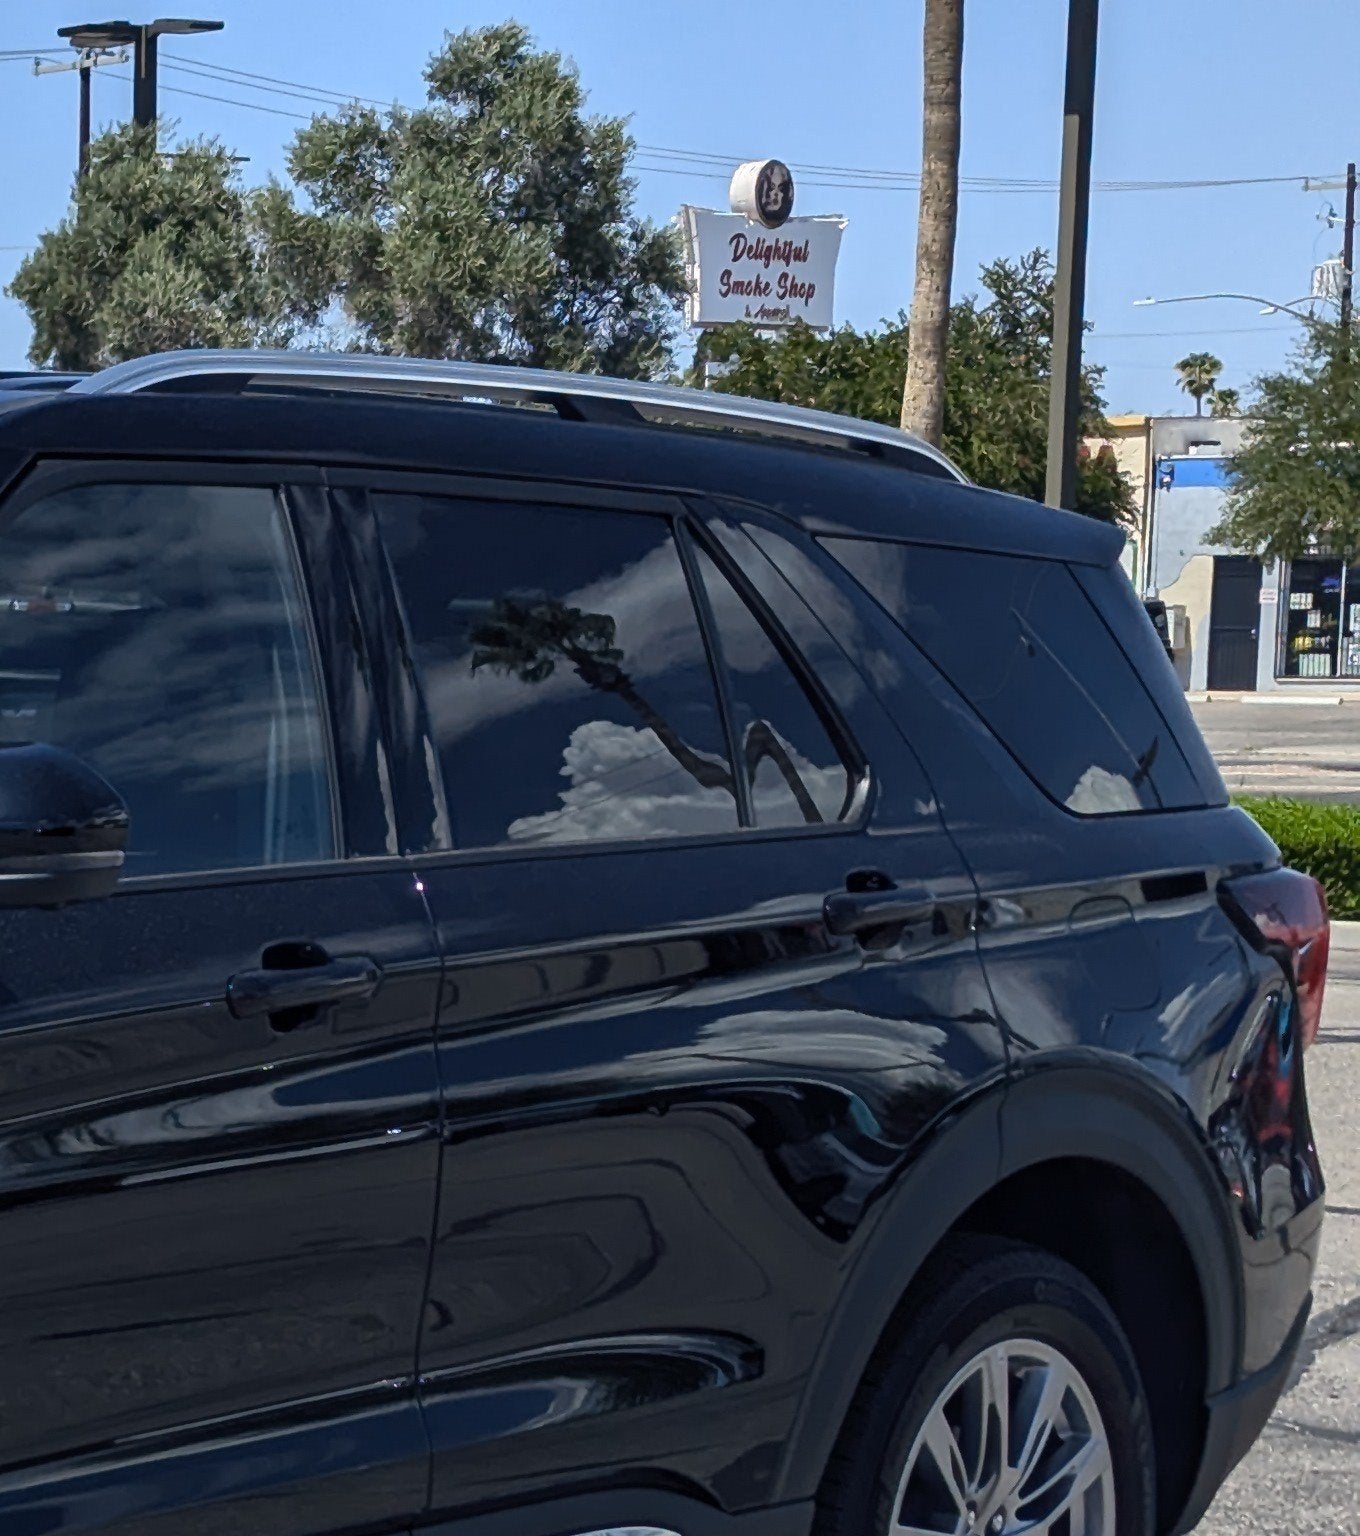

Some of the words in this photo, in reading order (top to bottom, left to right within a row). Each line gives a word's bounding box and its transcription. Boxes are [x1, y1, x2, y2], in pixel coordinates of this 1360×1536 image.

[729, 232, 810, 269] Delightful
[718, 269, 773, 298] Smoke
[776, 271, 816, 306] Shop
